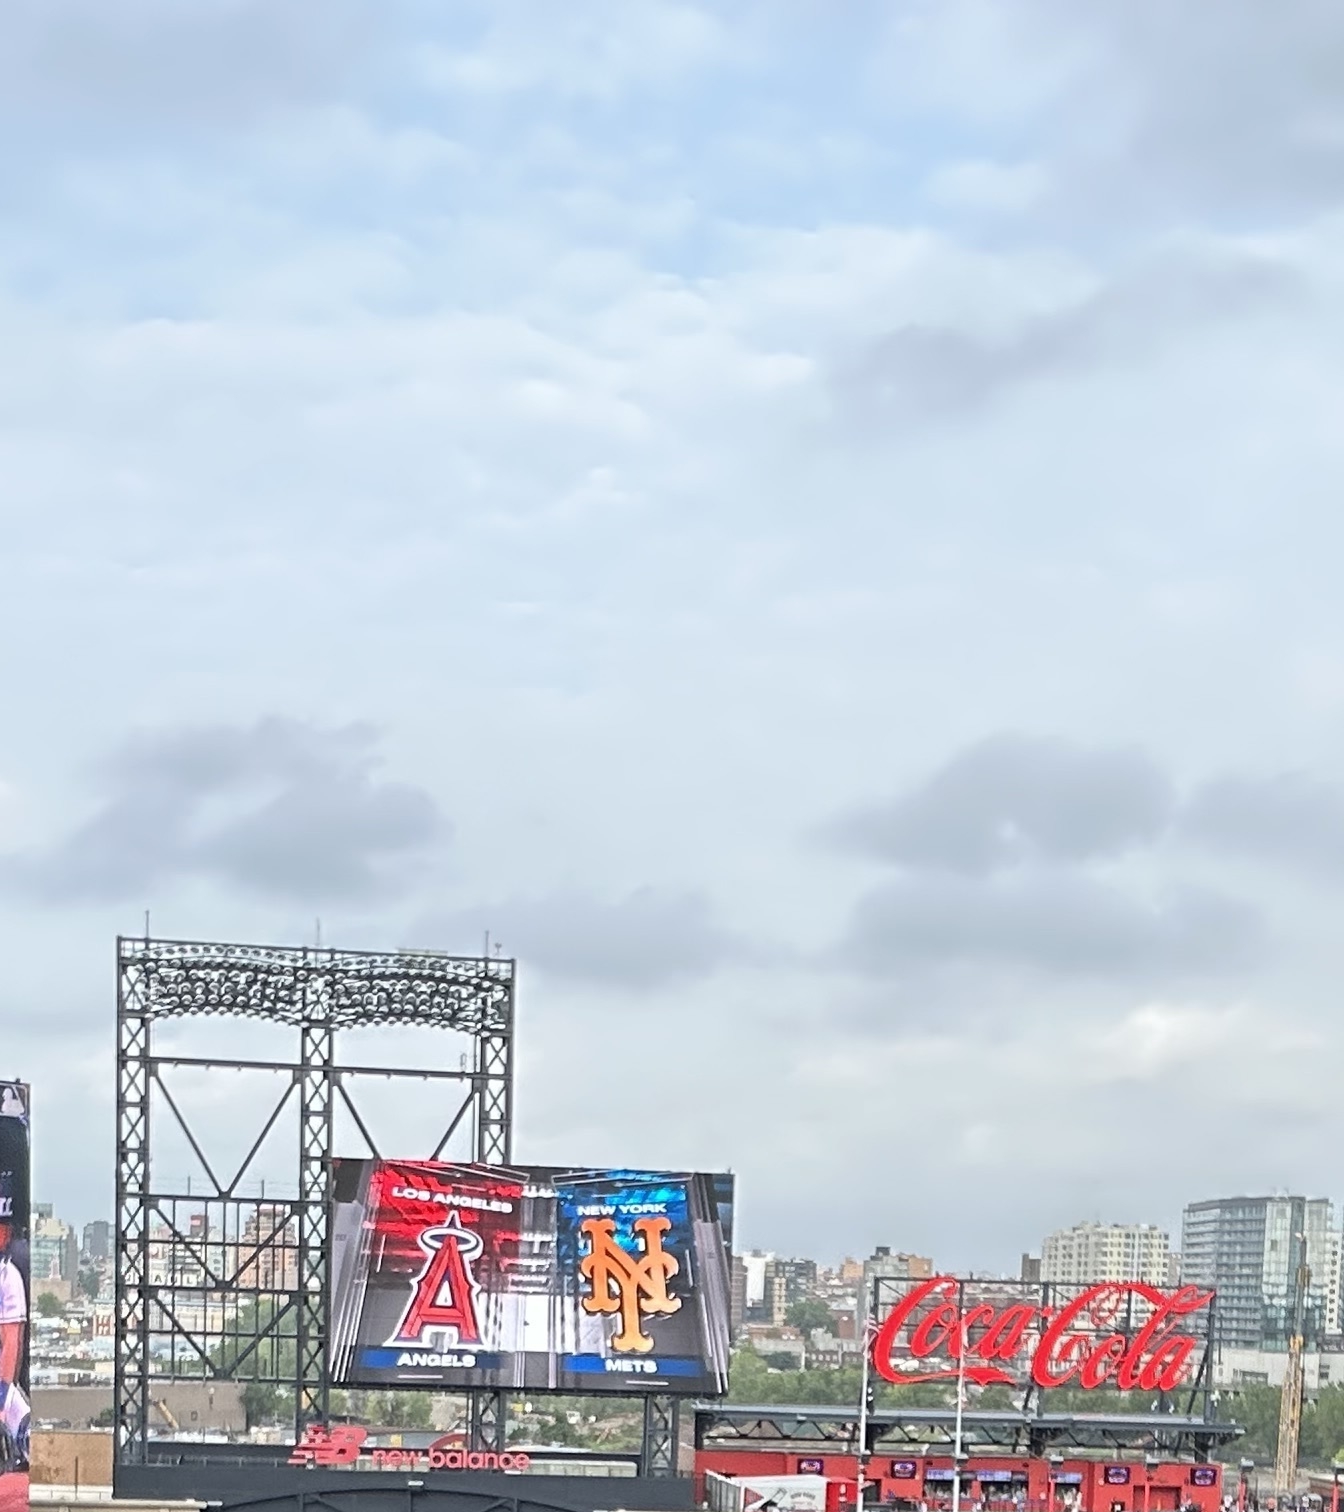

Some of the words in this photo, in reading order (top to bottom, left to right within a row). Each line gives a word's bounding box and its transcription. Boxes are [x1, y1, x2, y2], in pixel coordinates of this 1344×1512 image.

[393, 1186, 431, 1201] LOS
[433, 1192, 513, 1214] ANGELES
[577, 1204, 615, 1217] NEW
[619, 1202, 668, 1215] YORK
[871, 1275, 1215, 1391] Coca-Cola
[397, 1352, 476, 1368] ANGELS
[605, 1358, 658, 1374] METS
[372, 1450, 423, 1467] new
[428, 1447, 531, 1471] balance
